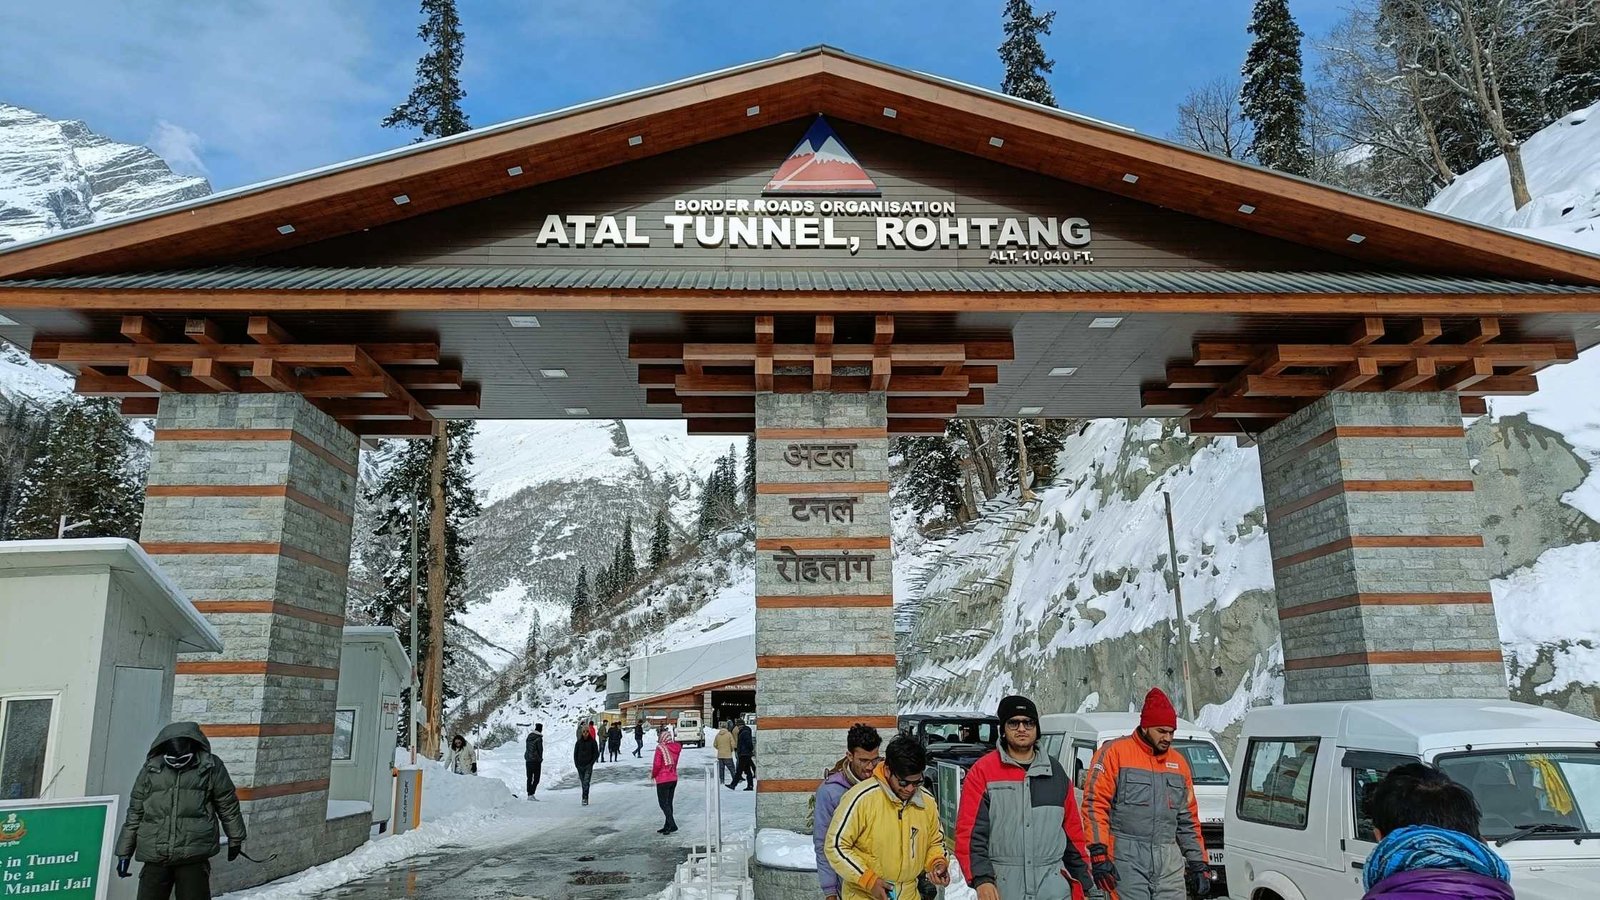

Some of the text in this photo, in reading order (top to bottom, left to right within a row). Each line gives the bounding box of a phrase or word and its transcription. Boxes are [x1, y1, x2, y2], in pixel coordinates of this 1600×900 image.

[674, 199, 956, 215] BORDER ROADS ORGANISATION
[535, 214, 1092, 254] ATAL TUNNEL, ROHTANG
[989, 250, 1094, 264] ALT. 10,040 FT.
[783, 443, 858, 469] अटल
[788, 496, 858, 523] टनल
[772, 545, 875, 582] रोहतांग
[7, 856, 21, 868] in
[26, 851, 79, 866] Tunnel
[1213, 852, 1225, 863] HP
[3, 870, 35, 882] be a
[4, 876, 92, 895] Manali Jail
